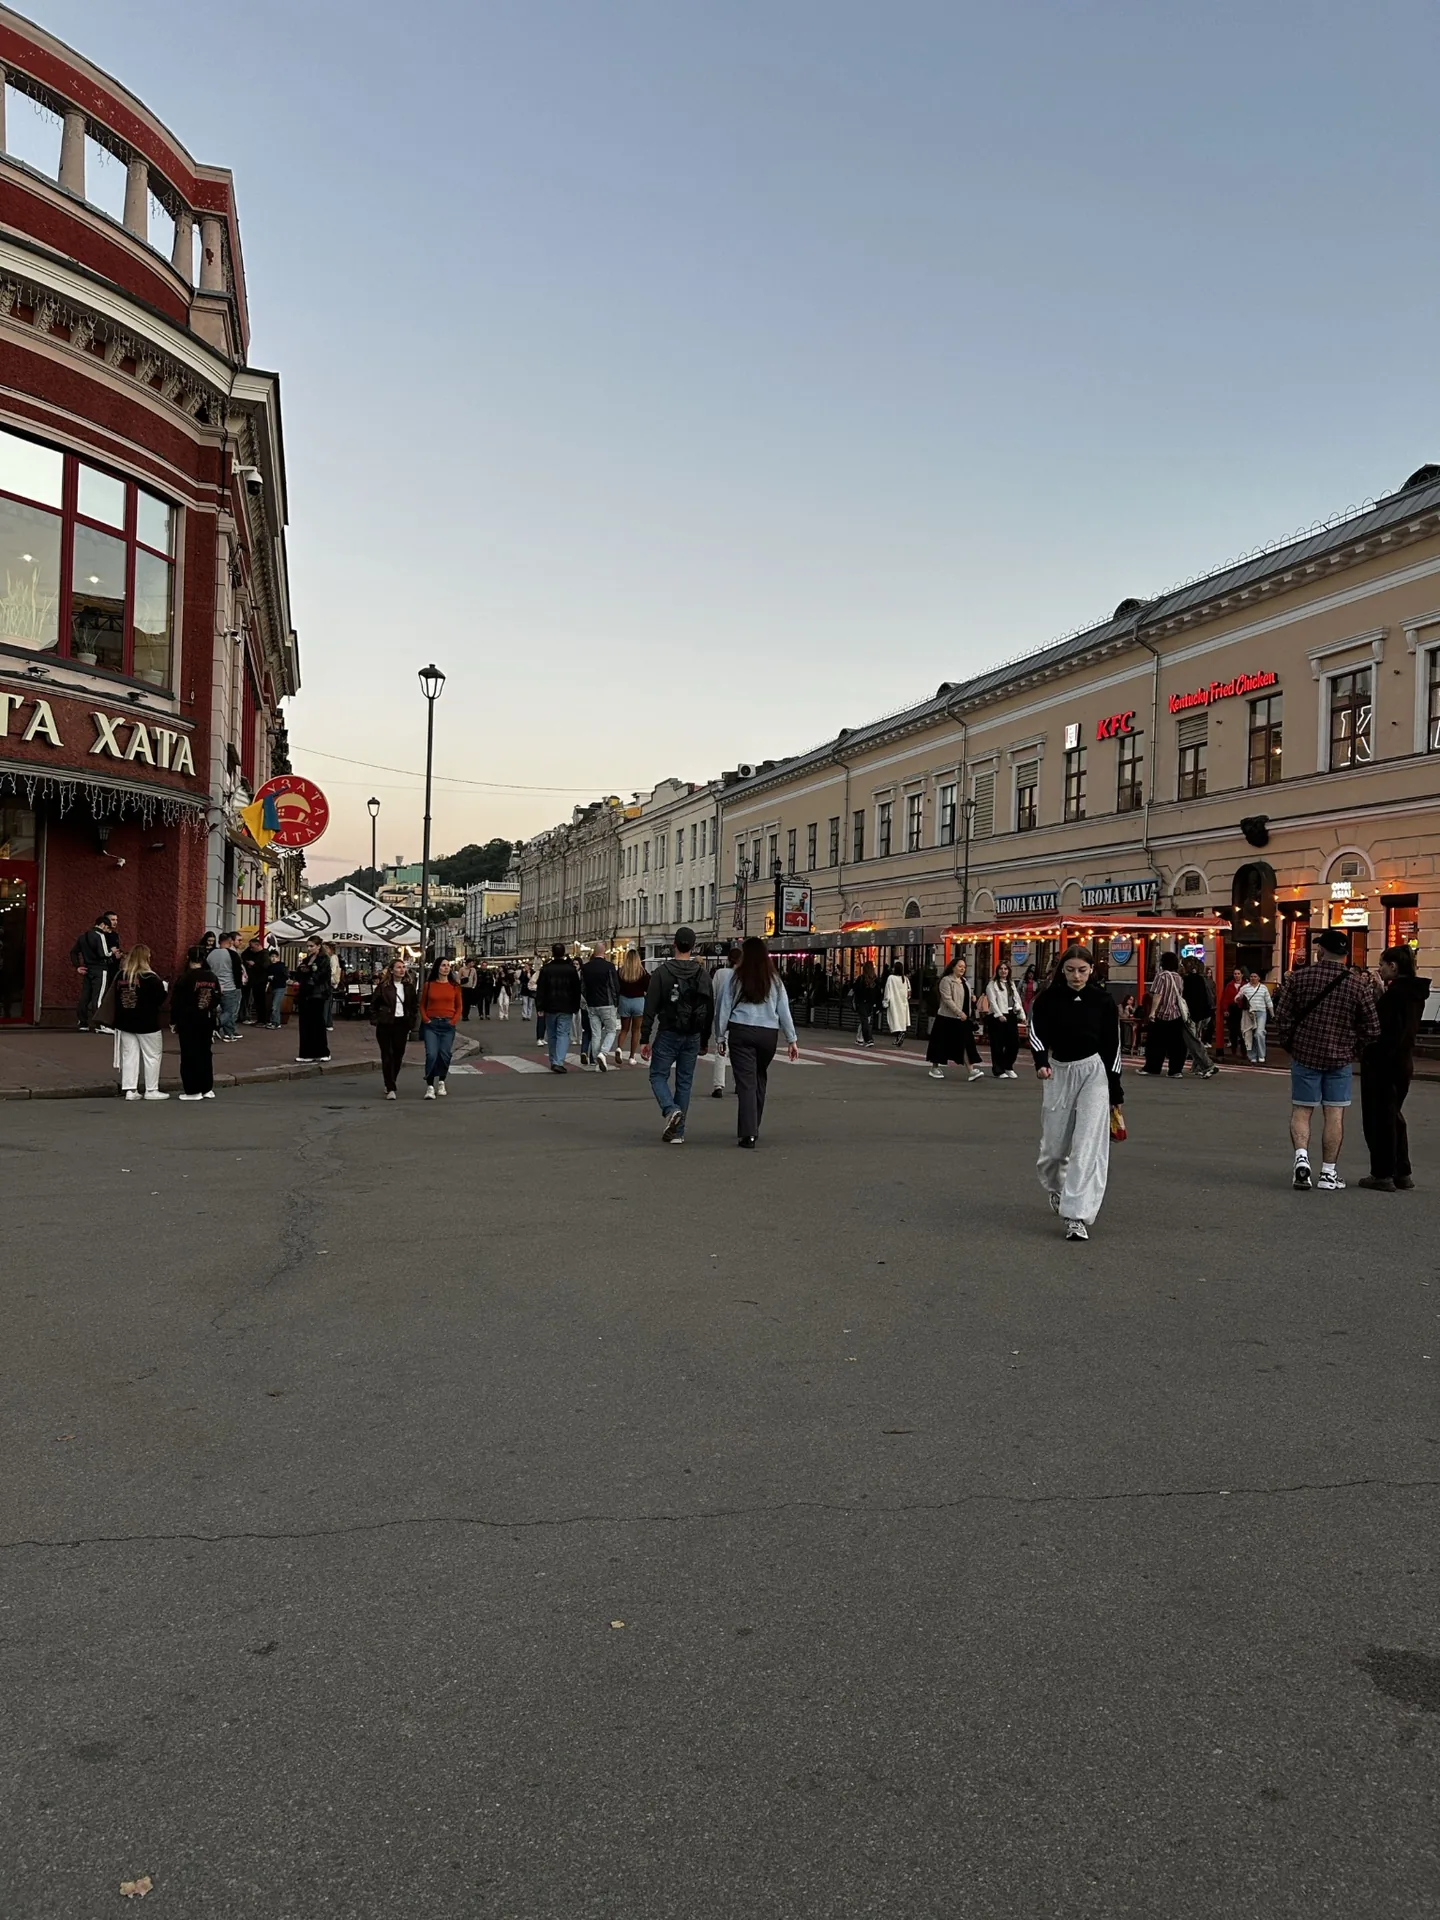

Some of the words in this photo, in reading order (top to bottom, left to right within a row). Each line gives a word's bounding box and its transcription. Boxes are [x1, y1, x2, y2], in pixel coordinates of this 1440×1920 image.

[1169, 688, 1209, 713] Kentucky
[1209, 679, 1235, 702] Fried
[1235, 670, 1276, 696] Chicken
[1096, 711, 1134, 740] KFC
[89, 711, 197, 776] ХАТА
[267, 779, 325, 816] УЗАТА
[279, 827, 316, 842] АТА
[996, 897, 1027, 913] AROMA
[1028, 894, 1055, 911] KAVA
[1082, 887, 1120, 906] AROMA
[1123, 883, 1157, 903] KAVA
[332, 933, 363, 941] PEPSI
